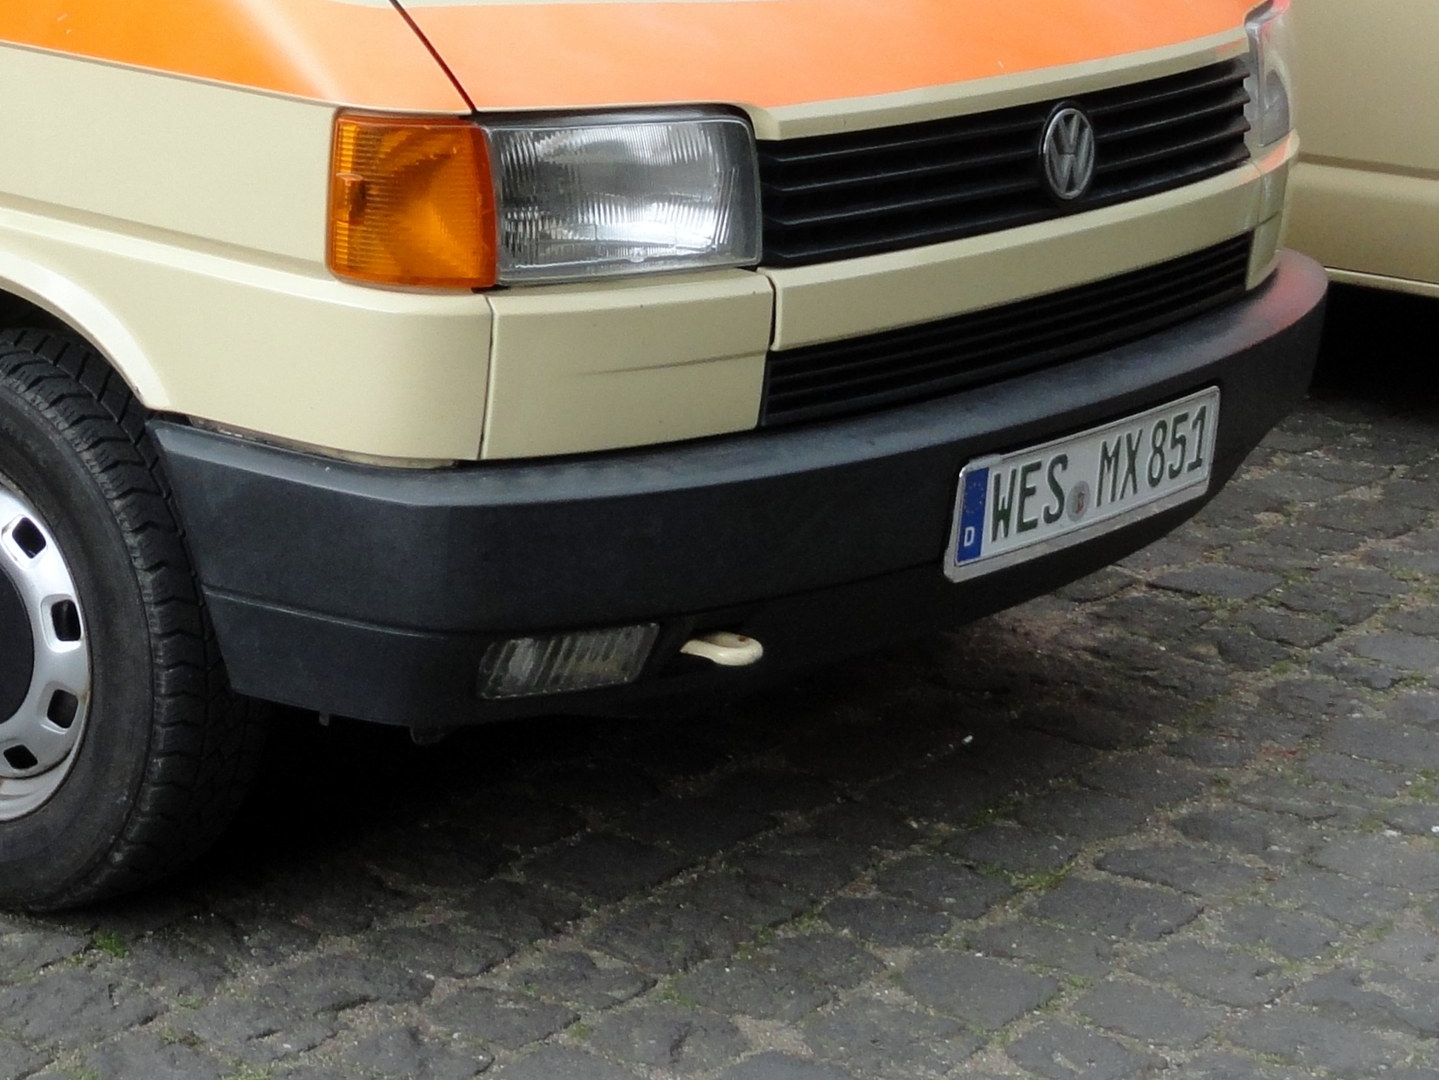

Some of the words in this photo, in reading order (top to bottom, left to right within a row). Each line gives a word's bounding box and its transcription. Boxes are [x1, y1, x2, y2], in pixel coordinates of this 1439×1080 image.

[990, 453, 1068, 543] WES
[1096, 428, 1143, 507] MX
[1146, 405, 1207, 489] 851
